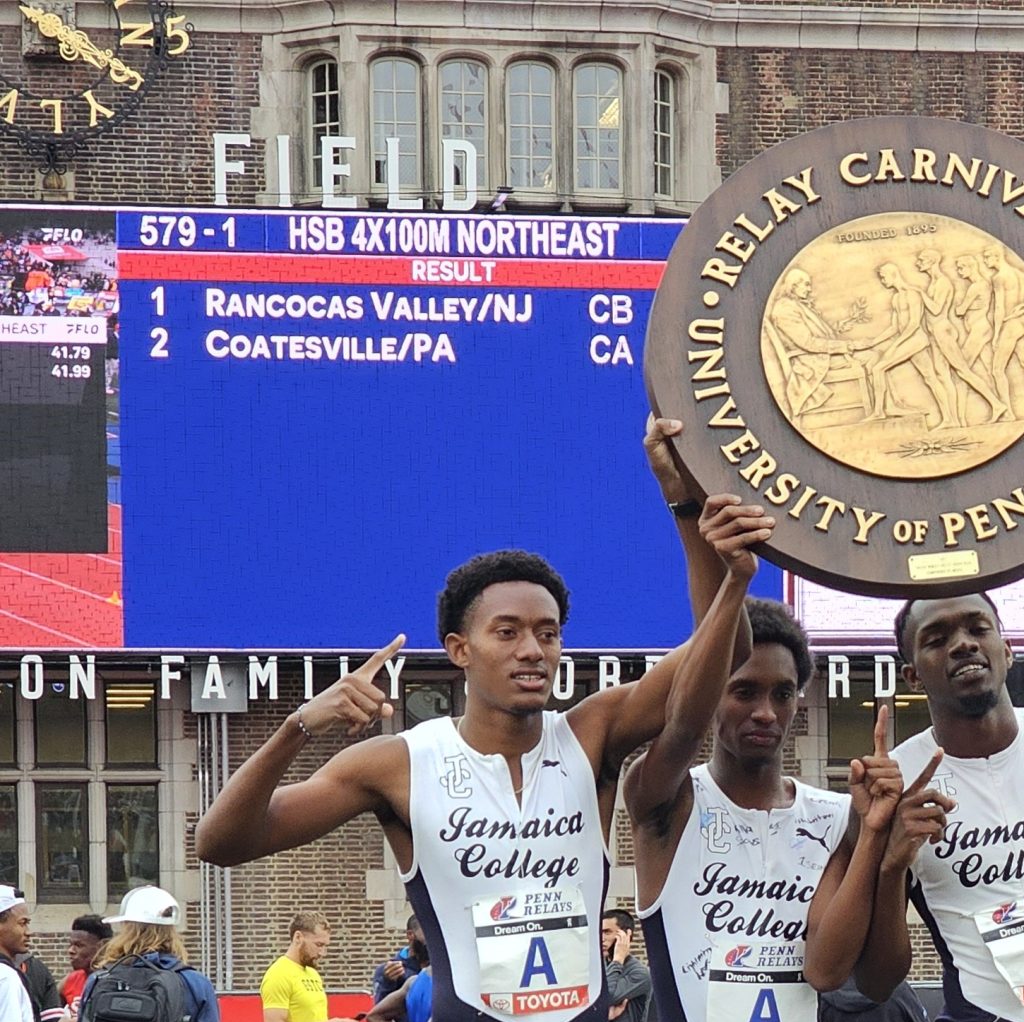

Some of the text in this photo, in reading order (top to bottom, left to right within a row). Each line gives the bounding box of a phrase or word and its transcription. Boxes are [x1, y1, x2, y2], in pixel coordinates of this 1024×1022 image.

[212, 133, 479, 211] FIELD
[139, 215, 196, 247] 579
[222, 217, 236, 248] 1
[289, 216, 620, 257] HSB 4X100M NORTHEAST
[701, 166, 821, 288] RELAY
[838, 223, 937, 243] FOUNDED 1895
[411, 259, 497, 283] RESULT
[150, 286, 165, 316] 1
[588, 294, 634, 325] CB
[51, 346, 91, 360] 41.79
[150, 327, 169, 358] 2
[589, 334, 634, 365] CA
[51, 364, 91, 378] 41.99
[688, 316, 885, 545] UNIVERSITY
[893, 519, 928, 545] OF
[440, 806, 586, 842] Jamaica
[455, 843, 580, 889] College
[694, 862, 814, 902] Jamaic
[524, 891, 563, 904] PENN
[524, 901, 573, 916] RELAYS
[494, 924, 526, 936] Dream
[703, 901, 809, 942] Colleg
[520, 936, 558, 988] A
[757, 956, 804, 966] RELAYS
[761, 946, 796, 955] PENN
[726, 972, 756, 982] Dream
[517, 990, 579, 1010] TOYOTA
